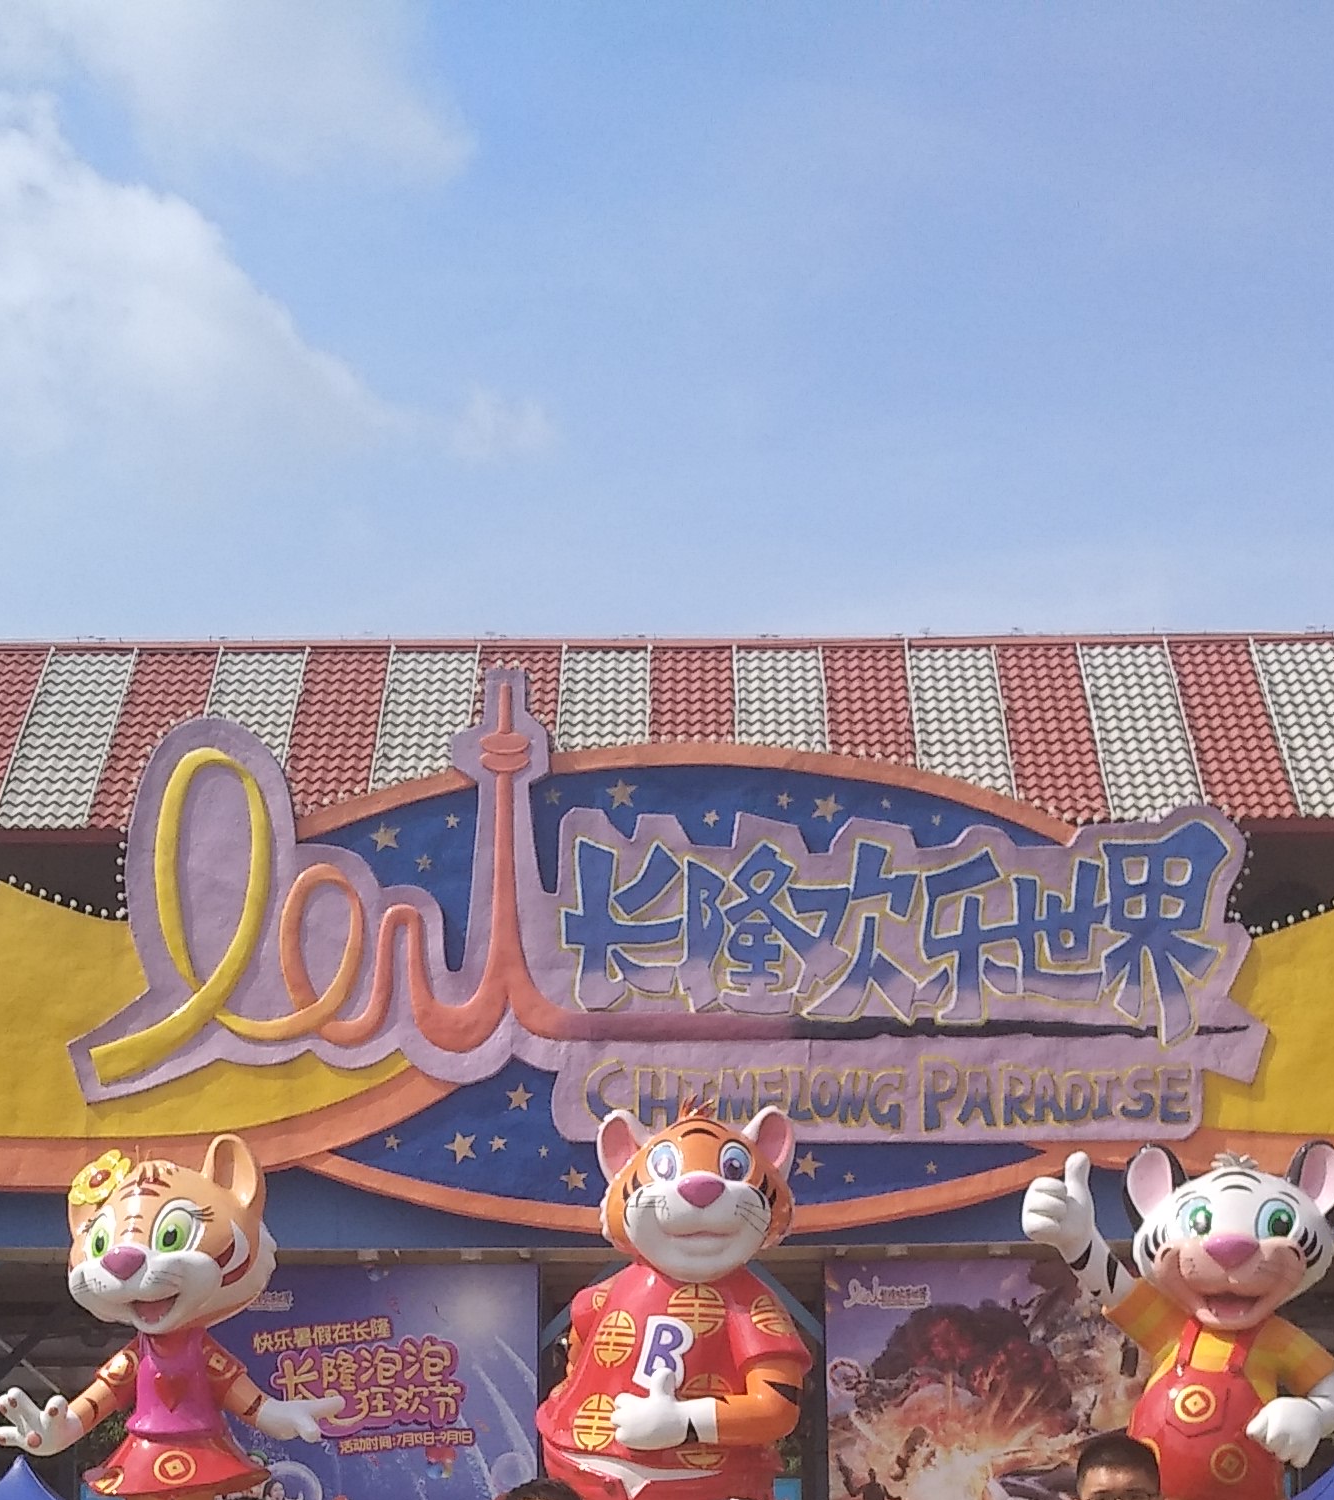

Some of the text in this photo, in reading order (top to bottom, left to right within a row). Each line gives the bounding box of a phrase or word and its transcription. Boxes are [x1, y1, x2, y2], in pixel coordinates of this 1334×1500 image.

[561, 818, 1231, 1046] 长隆欢乐世界
[920, 1054, 1193, 1136] PARADISE
[253, 1317, 391, 1353] 快乐暑假在长隆
[644, 1324, 684, 1377] R
[277, 1340, 452, 1401] 长隆泡泡
[331, 1382, 462, 1426] 狂欢节
